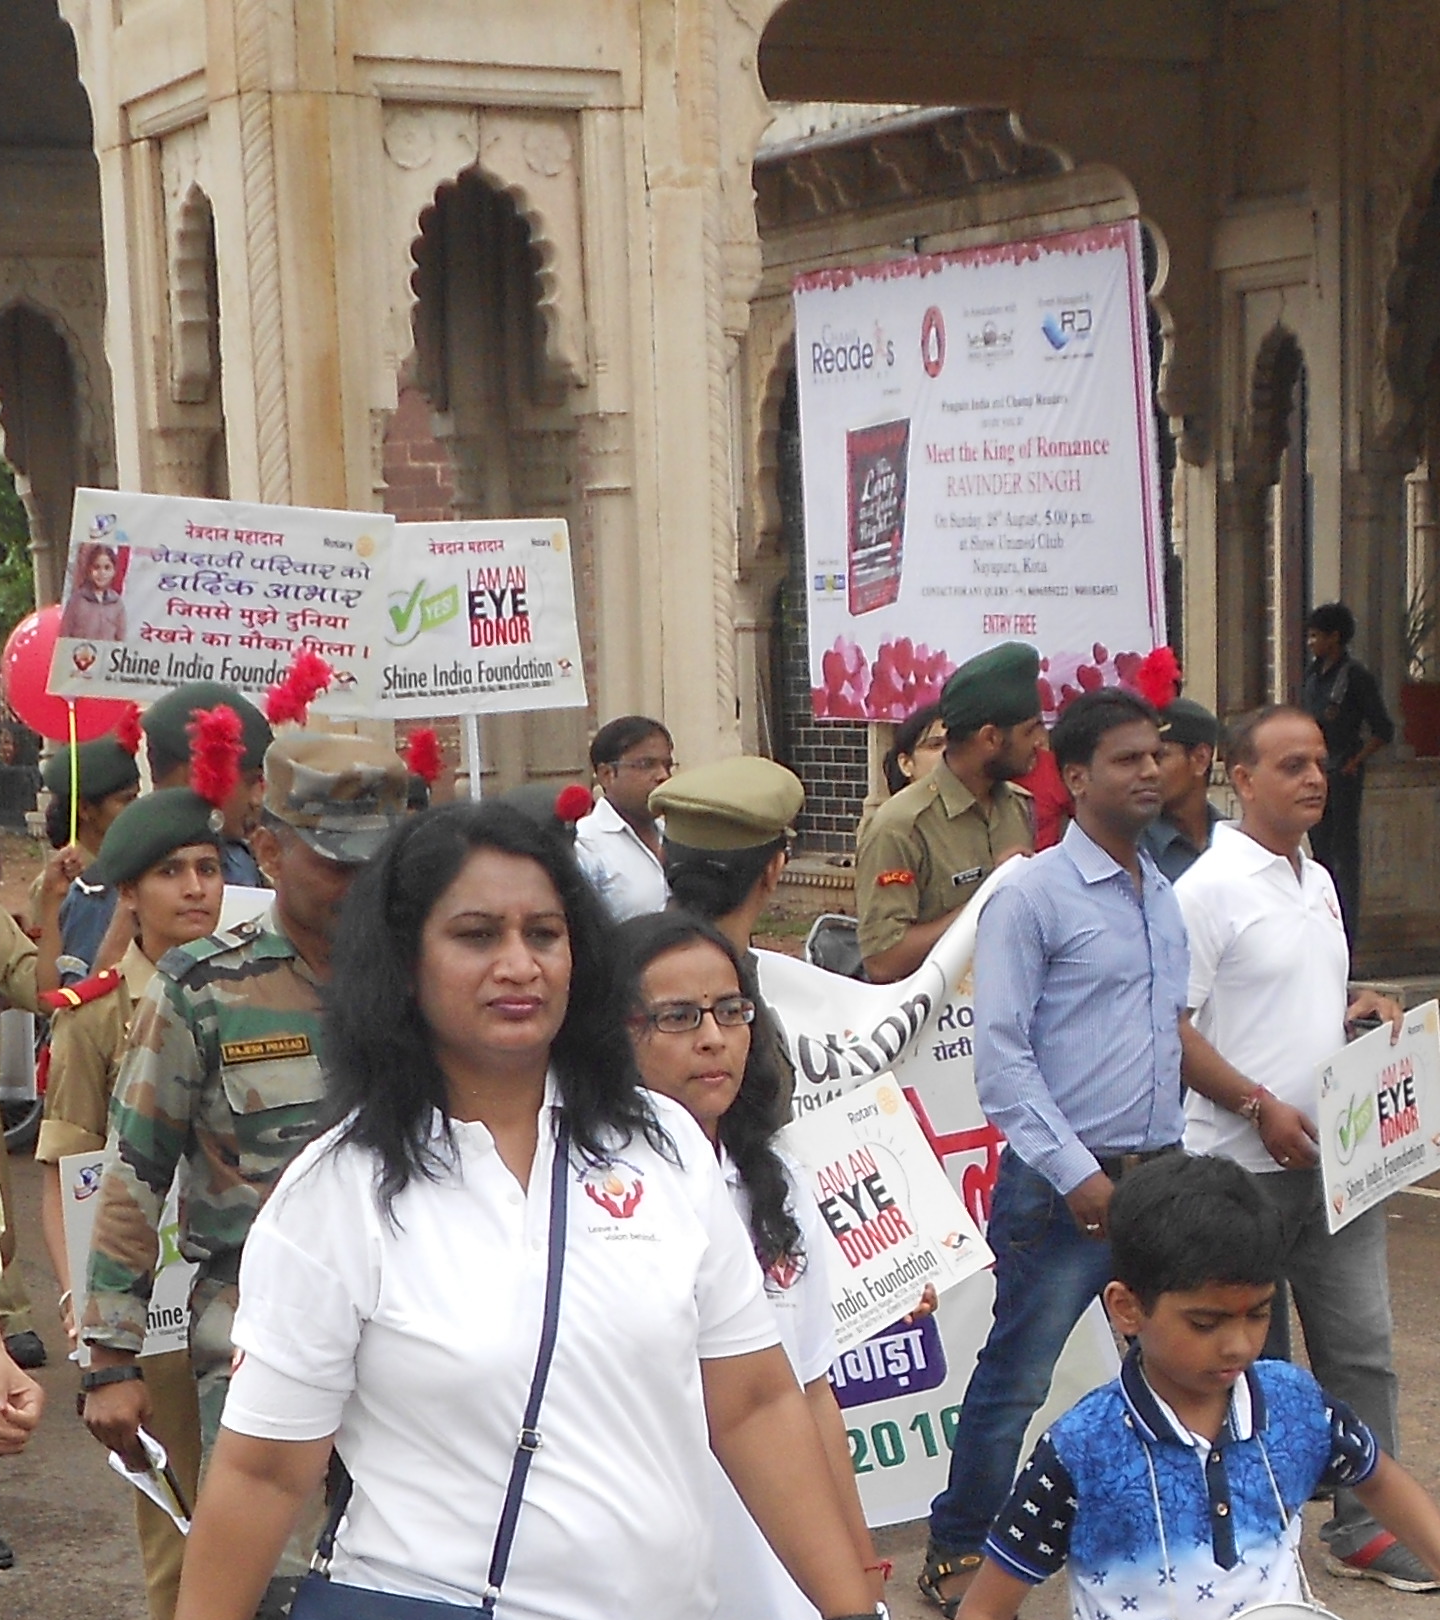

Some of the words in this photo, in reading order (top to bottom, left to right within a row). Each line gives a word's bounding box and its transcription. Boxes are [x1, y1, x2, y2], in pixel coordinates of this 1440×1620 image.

[925, 443, 955, 464] Meet
[960, 441, 977, 462] the
[983, 438, 1015, 464] King
[1019, 436, 1033, 459] of
[1037, 435, 1110, 458] Romance
[947, 472, 1022, 498] RAVINDER
[1028, 469, 1081, 494] SINGH
[185, 520, 229, 542] नेत्रदान
[234, 527, 284, 547] महादान
[429, 537, 464, 556] नेत्रदान
[468, 539, 505, 555] महादान
[1038, 531, 1064, 549] Club
[250, 553, 336, 578] परिवार
[341, 561, 371, 581] को
[476, 567, 502, 591] AM
[506, 565, 527, 590] AN
[1023, 556, 1048, 573] Kota
[158, 570, 258, 597] हार्दिक
[264, 582, 362, 609] आभार
[468, 588, 529, 620] EYE
[166, 597, 233, 620] जिससे
[240, 604, 280, 628] मुझे
[286, 609, 350, 632] दुनिया
[983, 614, 1011, 634] ENTRY
[1014, 614, 1037, 634] FREE
[140, 621, 196, 645] देखने
[202, 631, 231, 648] का
[239, 629, 293, 652] मौका
[471, 615, 532, 647] DONOR
[109, 647, 160, 676] Shine
[167, 653, 214, 680] India
[383, 664, 427, 690] Shine
[434, 661, 472, 687] India
[478, 656, 553, 684] Foundation
[936, 1004, 975, 1032] Ro
[932, 1036, 973, 1062] रोटरी
[847, 1101, 879, 1125] Rotary
[1377, 1075, 1417, 1120] EYE
[1380, 1104, 1421, 1149] DONOR
[816, 1161, 852, 1199] AM
[848, 1144, 879, 1183] AN
[1346, 1179, 1364, 1201] Shine
[1365, 1162, 1384, 1188] India
[1384, 1142, 1426, 1177] Foundation
[818, 1171, 897, 1238] EYE
[838, 1204, 914, 1269] DONOR
[831, 1287, 869, 1323] India
[862, 1249, 939, 1302] Foundation
